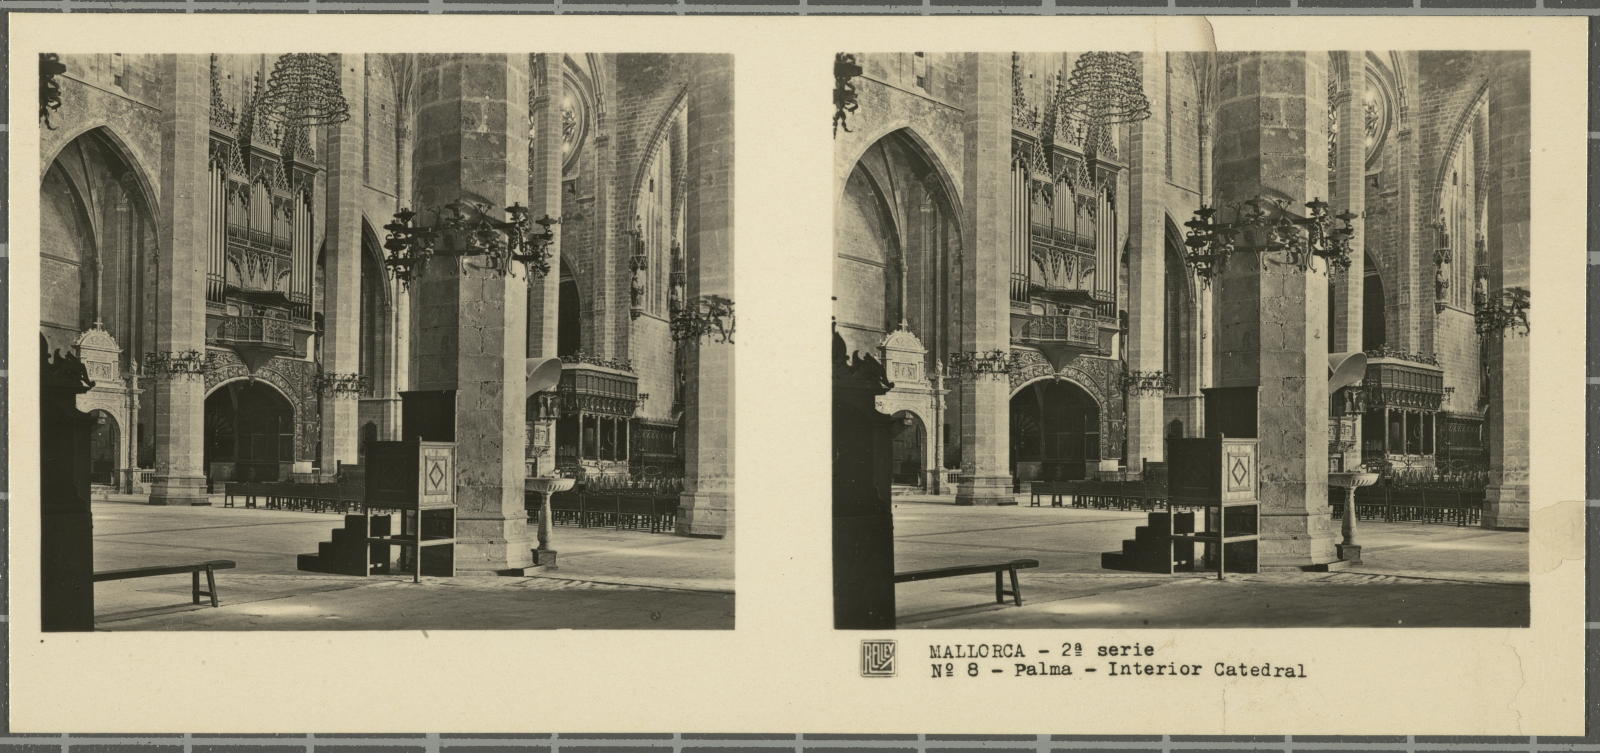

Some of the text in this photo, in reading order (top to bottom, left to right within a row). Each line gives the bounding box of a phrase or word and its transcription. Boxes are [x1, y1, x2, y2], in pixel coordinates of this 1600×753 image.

[929, 643, 1026, 658] MALLORCA
[1097, 642, 1155, 657] serie
[967, 662, 979, 677] 8
[1014, 661, 1073, 677] Palma
[1108, 661, 1203, 677] Interior
[1214, 662, 1307, 678] Catedral
